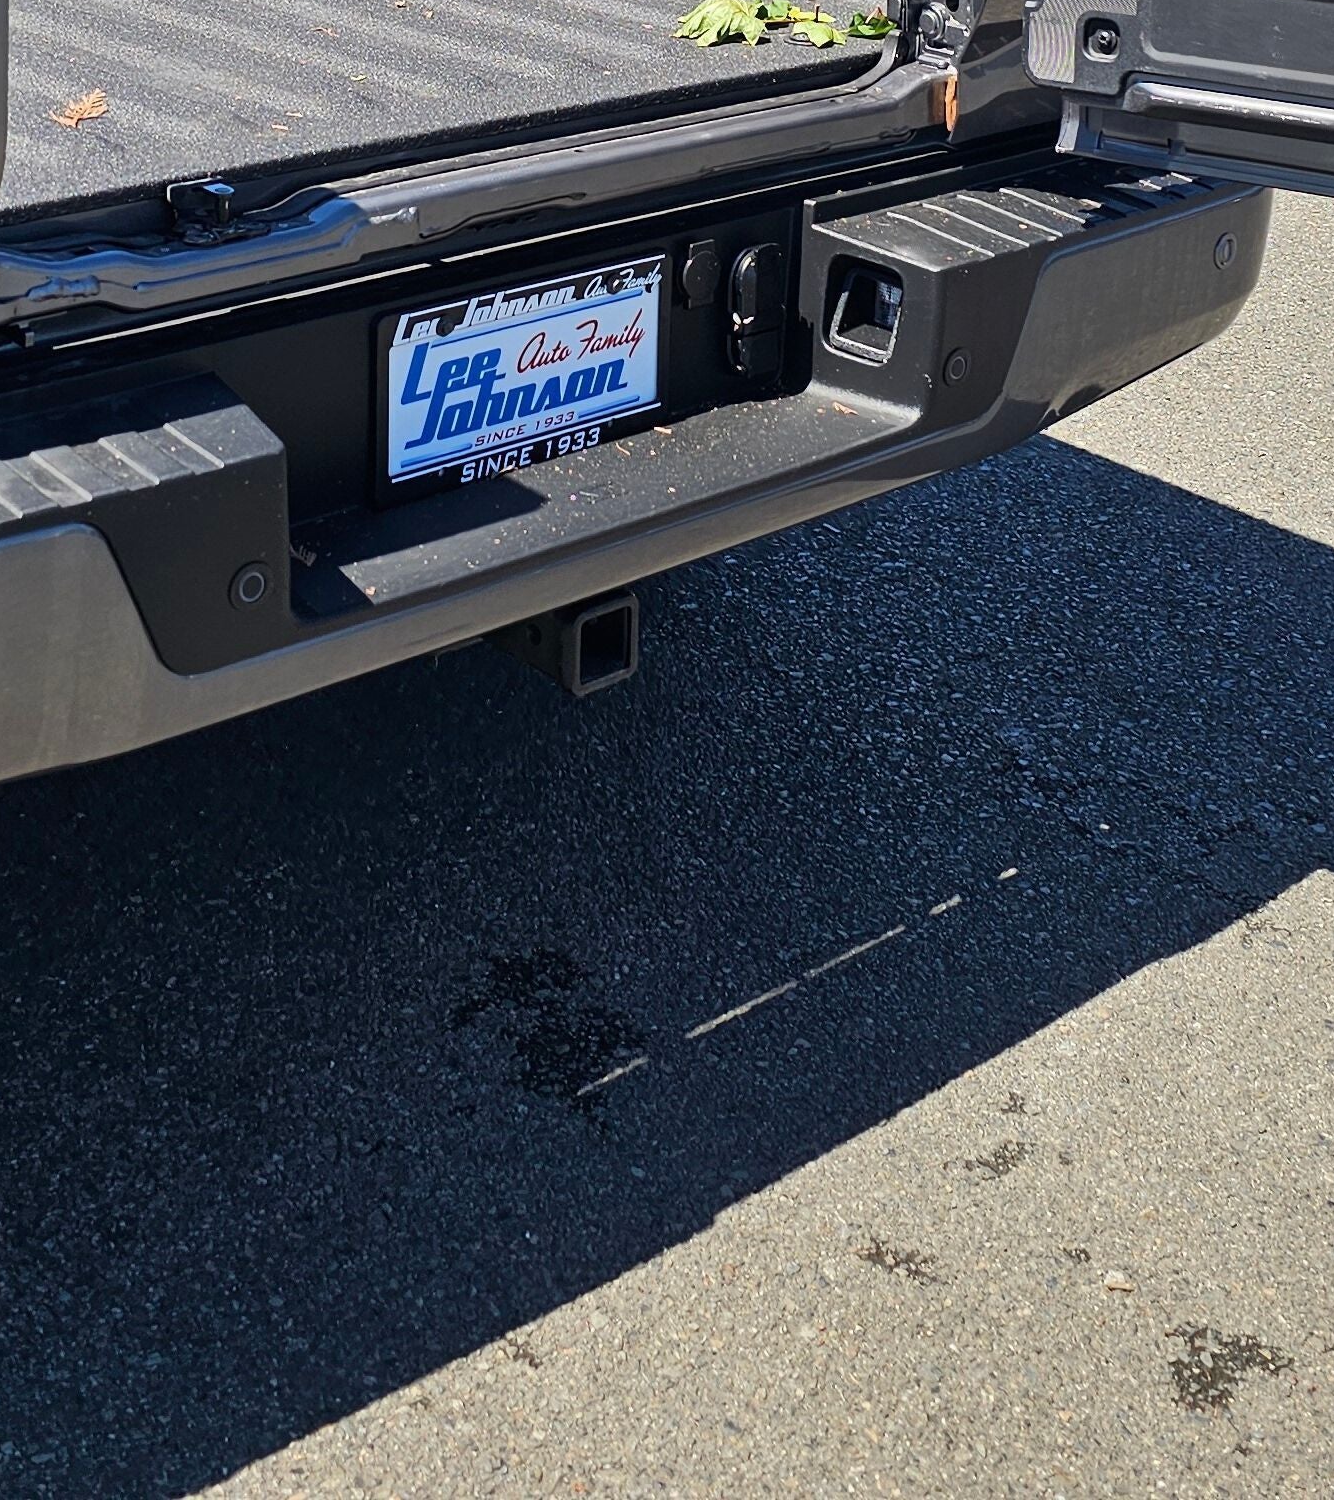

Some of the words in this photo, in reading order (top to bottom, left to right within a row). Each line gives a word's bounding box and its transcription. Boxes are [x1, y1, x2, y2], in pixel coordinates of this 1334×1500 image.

[453, 285, 576, 331] Johnson
[400, 342, 506, 405] Lee
[517, 331, 572, 375] Auto
[575, 307, 646, 360] Family
[404, 358, 628, 450] Johnson
[474, 424, 527, 448] SINCE
[534, 411, 576, 432] 1933
[460, 445, 533, 484] SINCE
[544, 426, 602, 460] 1933
